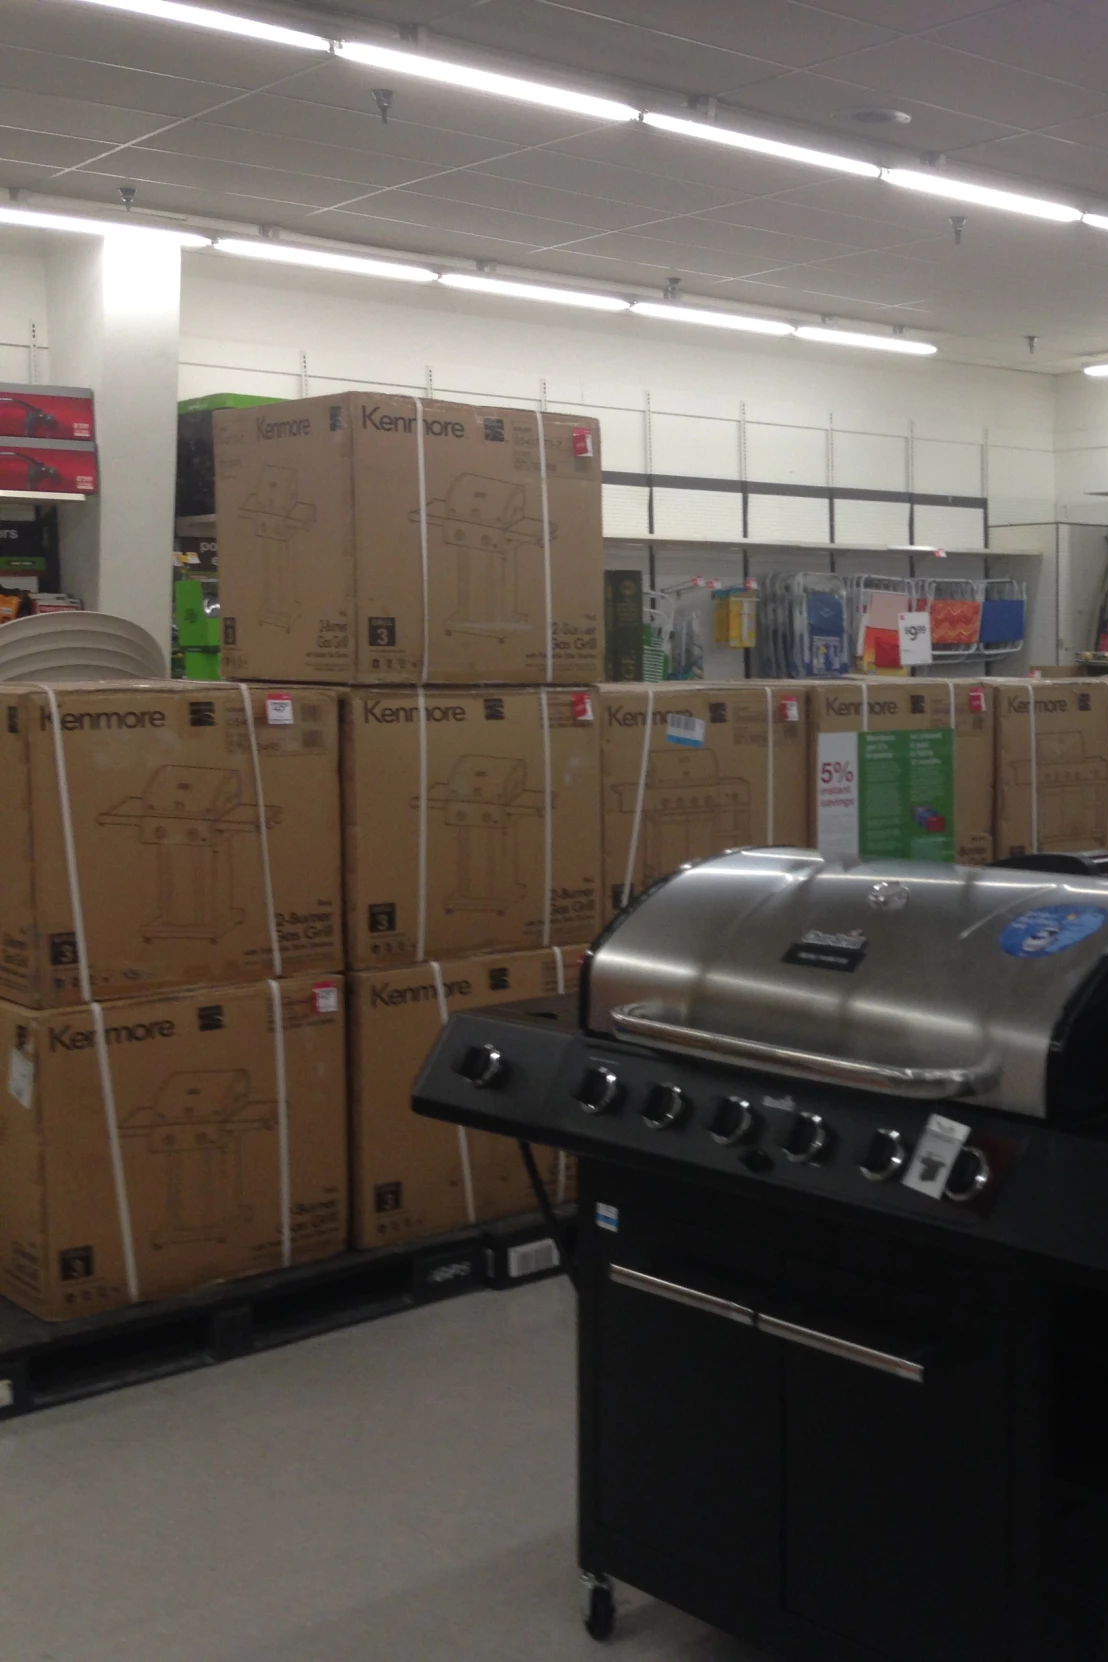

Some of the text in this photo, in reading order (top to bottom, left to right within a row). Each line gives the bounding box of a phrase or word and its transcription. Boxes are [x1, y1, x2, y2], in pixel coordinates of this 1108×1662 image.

[256, 415, 311, 440] Kenmore
[361, 405, 466, 438] Kenmore
[363, 700, 467, 724] Kenmore
[826, 696, 898, 717] Kenmore
[1007, 694, 1069, 713] Kemore
[821, 761, 854, 783] 5%
